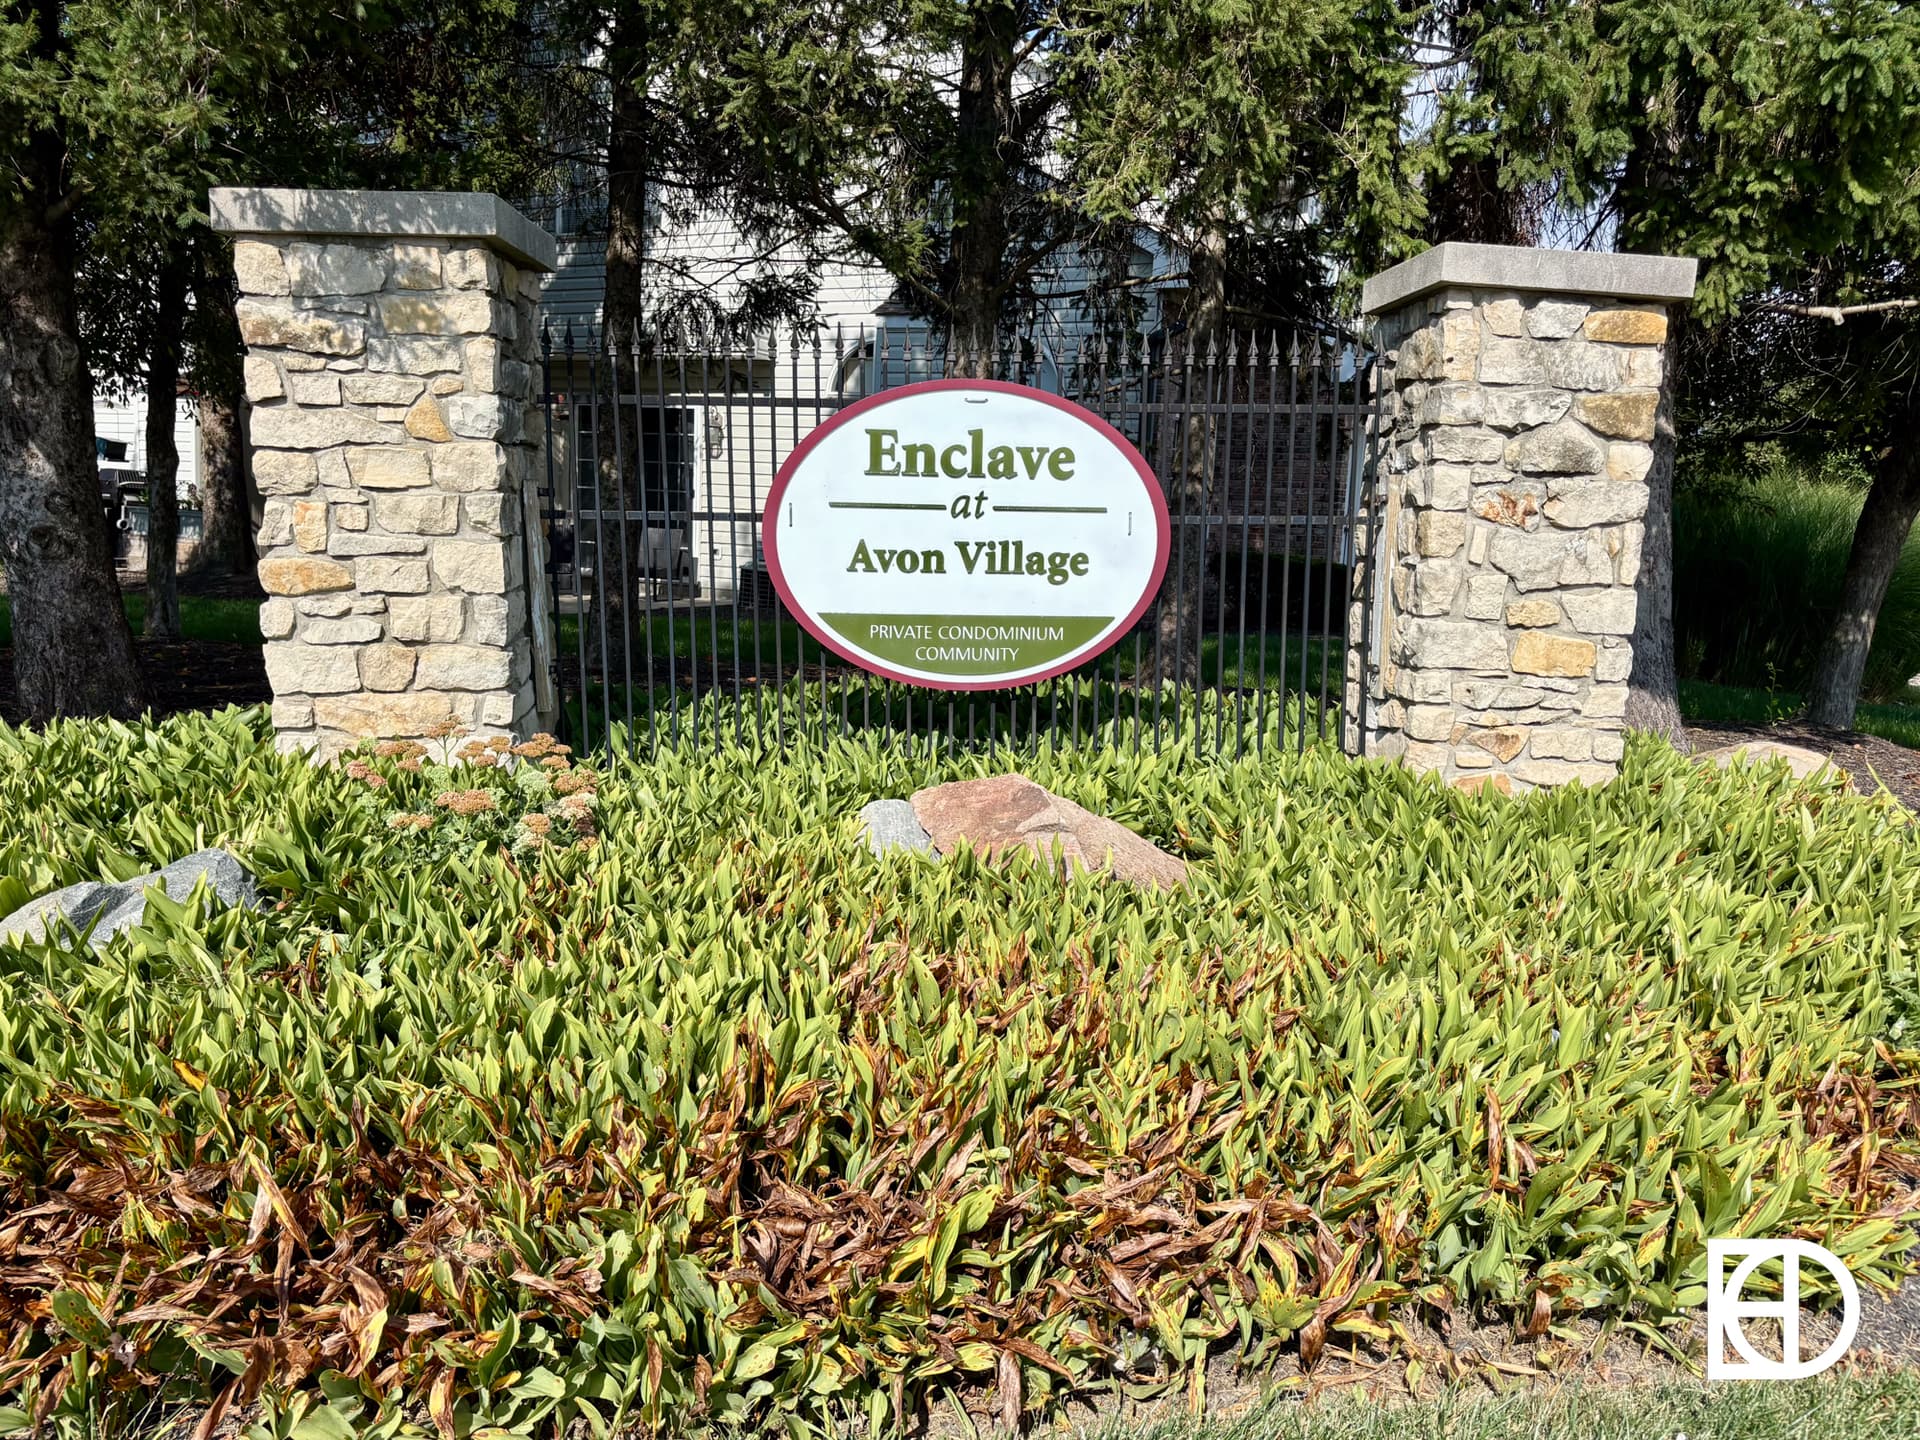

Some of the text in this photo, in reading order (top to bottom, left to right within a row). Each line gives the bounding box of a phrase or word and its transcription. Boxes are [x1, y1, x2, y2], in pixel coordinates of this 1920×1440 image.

[864, 428, 1075, 481] Enclave
[950, 489, 989, 519] at
[846, 538, 1089, 586] Avon Village
[869, 624, 1064, 641] PRIVATE CONDOMINIUM
[915, 646, 1020, 662] COMMUNITY
